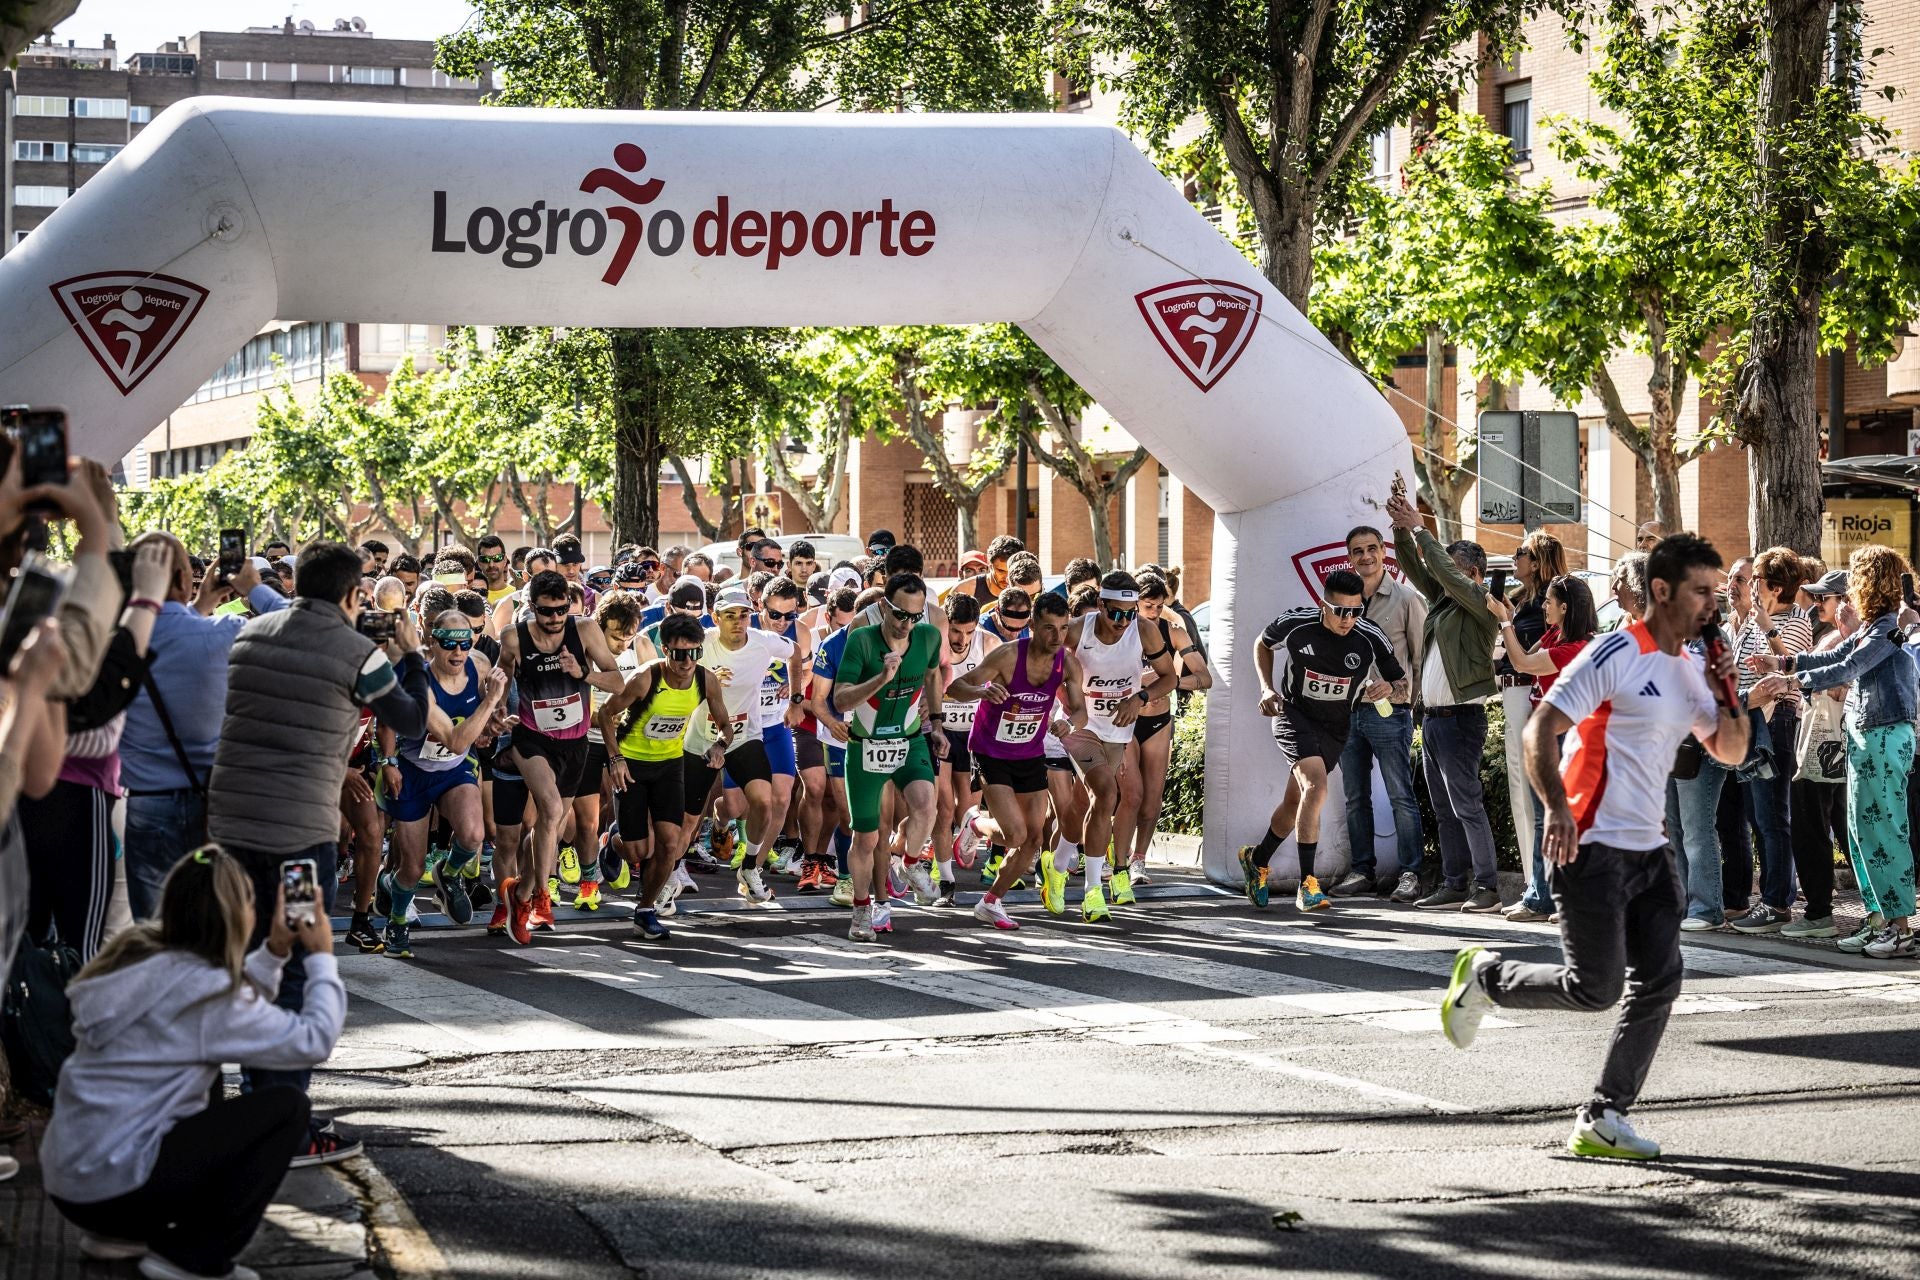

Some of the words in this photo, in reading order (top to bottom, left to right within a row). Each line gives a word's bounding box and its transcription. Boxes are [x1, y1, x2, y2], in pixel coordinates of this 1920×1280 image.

[432, 165, 685, 286] Logroño
[692, 195, 936, 270] deporte
[81, 291, 120, 305] Logroño
[144, 295, 181, 310] deporte
[1162, 300, 1197, 314] Logroño
[1216, 299, 1246, 311] deporte
[1842, 514, 1891, 535] Rioja
[448, 630, 470, 638] NIKE
[545, 662, 561, 671] BAR
[1308, 680, 1345, 695] 618
[1093, 699, 1119, 711] 56
[553, 707, 567, 722] 3
[650, 722, 685, 733] 1298
[710, 722, 744, 735] 52
[1005, 722, 1038, 736] 156
[866, 748, 907, 763] 1075
